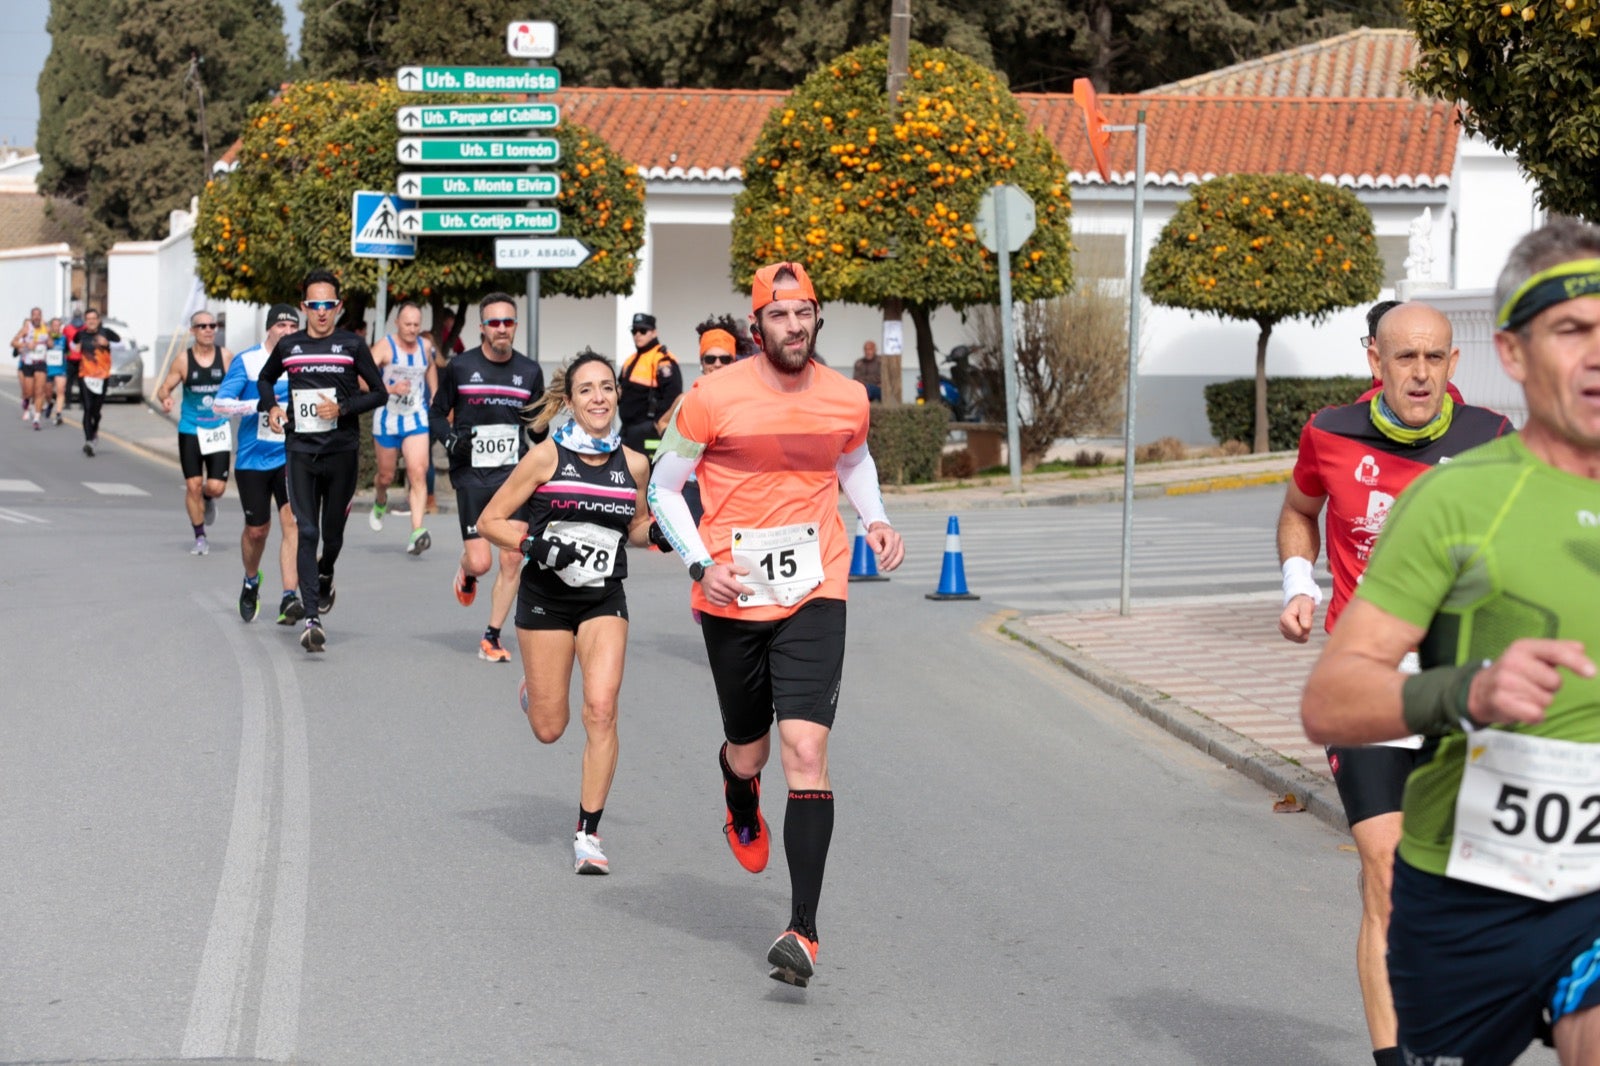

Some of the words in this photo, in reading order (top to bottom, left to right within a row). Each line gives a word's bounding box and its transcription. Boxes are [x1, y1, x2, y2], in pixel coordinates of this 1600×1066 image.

[426, 72, 460, 88] Urb.
[465, 72, 556, 89] Buenavista
[424, 112, 446, 125] Urb.
[451, 111, 488, 126] Parque
[491, 111, 507, 122] del
[509, 109, 553, 122] Cubillas
[460, 143, 487, 156] Urb.
[490, 143, 503, 156] El
[506, 143, 552, 156] torreón
[443, 179, 470, 192] Urb.
[473, 179, 513, 192] Monte
[516, 179, 552, 192] Elvira
[440, 215, 467, 227] Urb.
[470, 214, 512, 229] Cortijo
[515, 214, 552, 227] Pretel
[206, 431, 226, 443] 280
[475, 438, 515, 454] 3067
[760, 549, 798, 581] 15
[1491, 782, 1600, 844] 502
